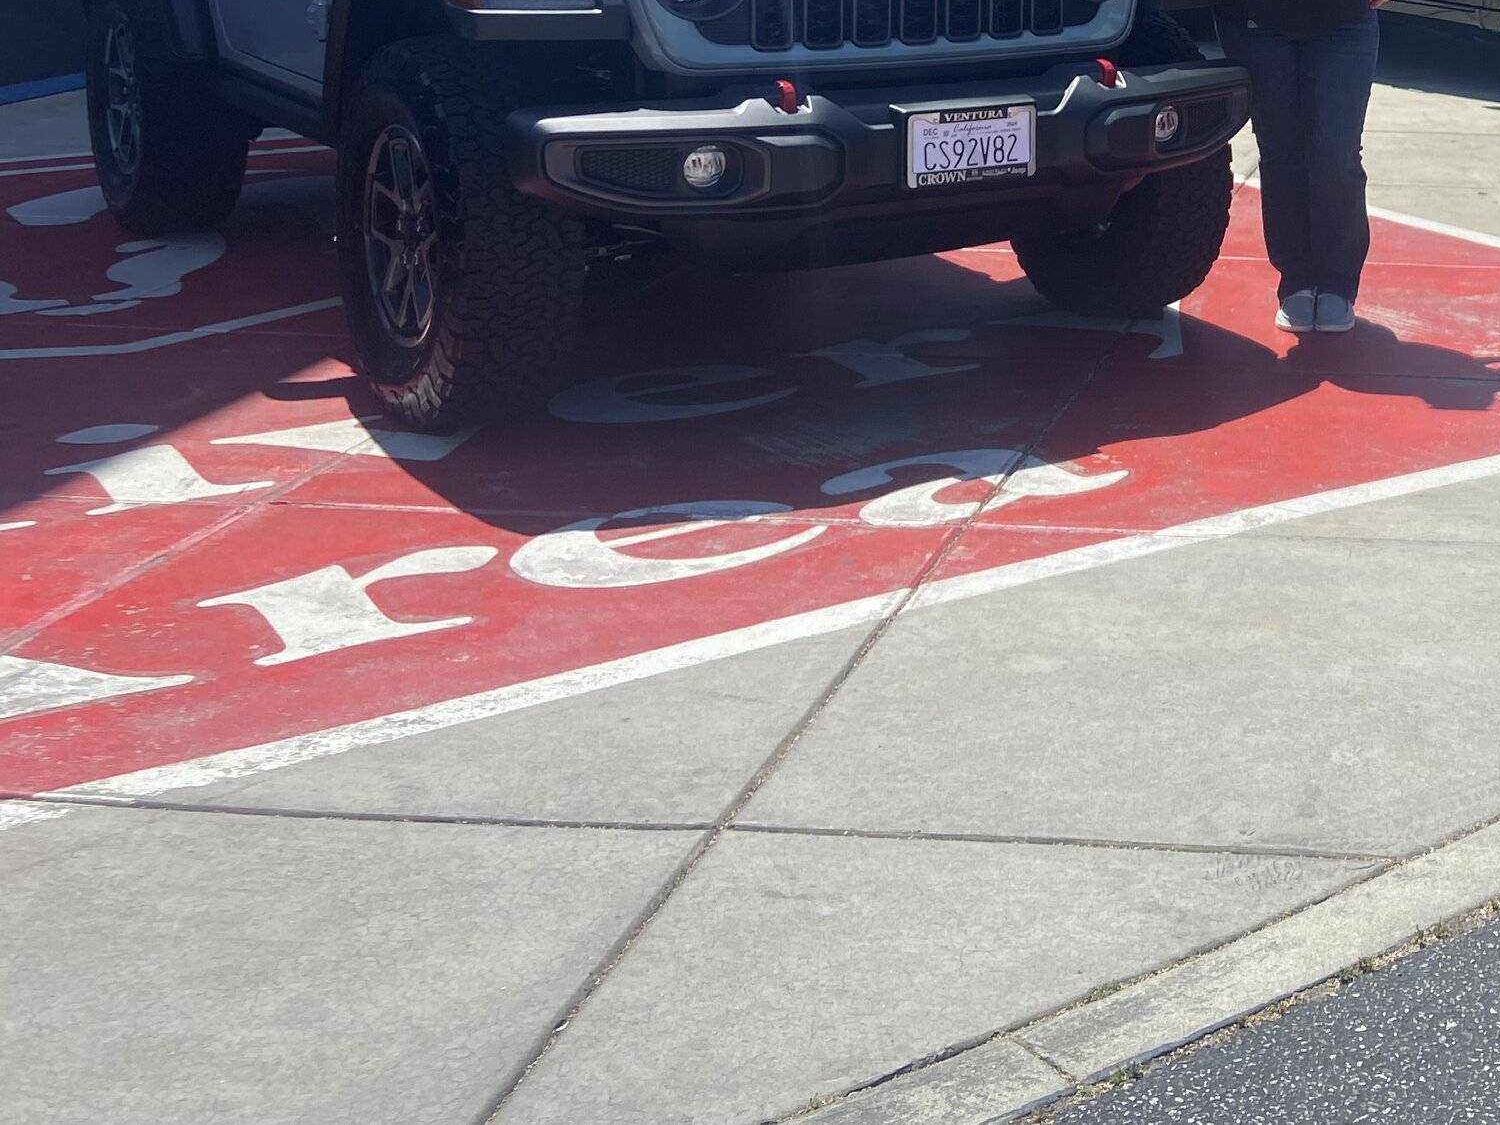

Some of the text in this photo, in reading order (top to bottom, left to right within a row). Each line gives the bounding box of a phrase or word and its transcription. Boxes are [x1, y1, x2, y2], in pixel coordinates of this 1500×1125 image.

[944, 110, 1004, 122] VENTURA
[923, 128, 938, 137] DEC
[953, 123, 992, 135] California
[924, 134, 1018, 171] CS92V82
[918, 170, 967, 186] CROWN
